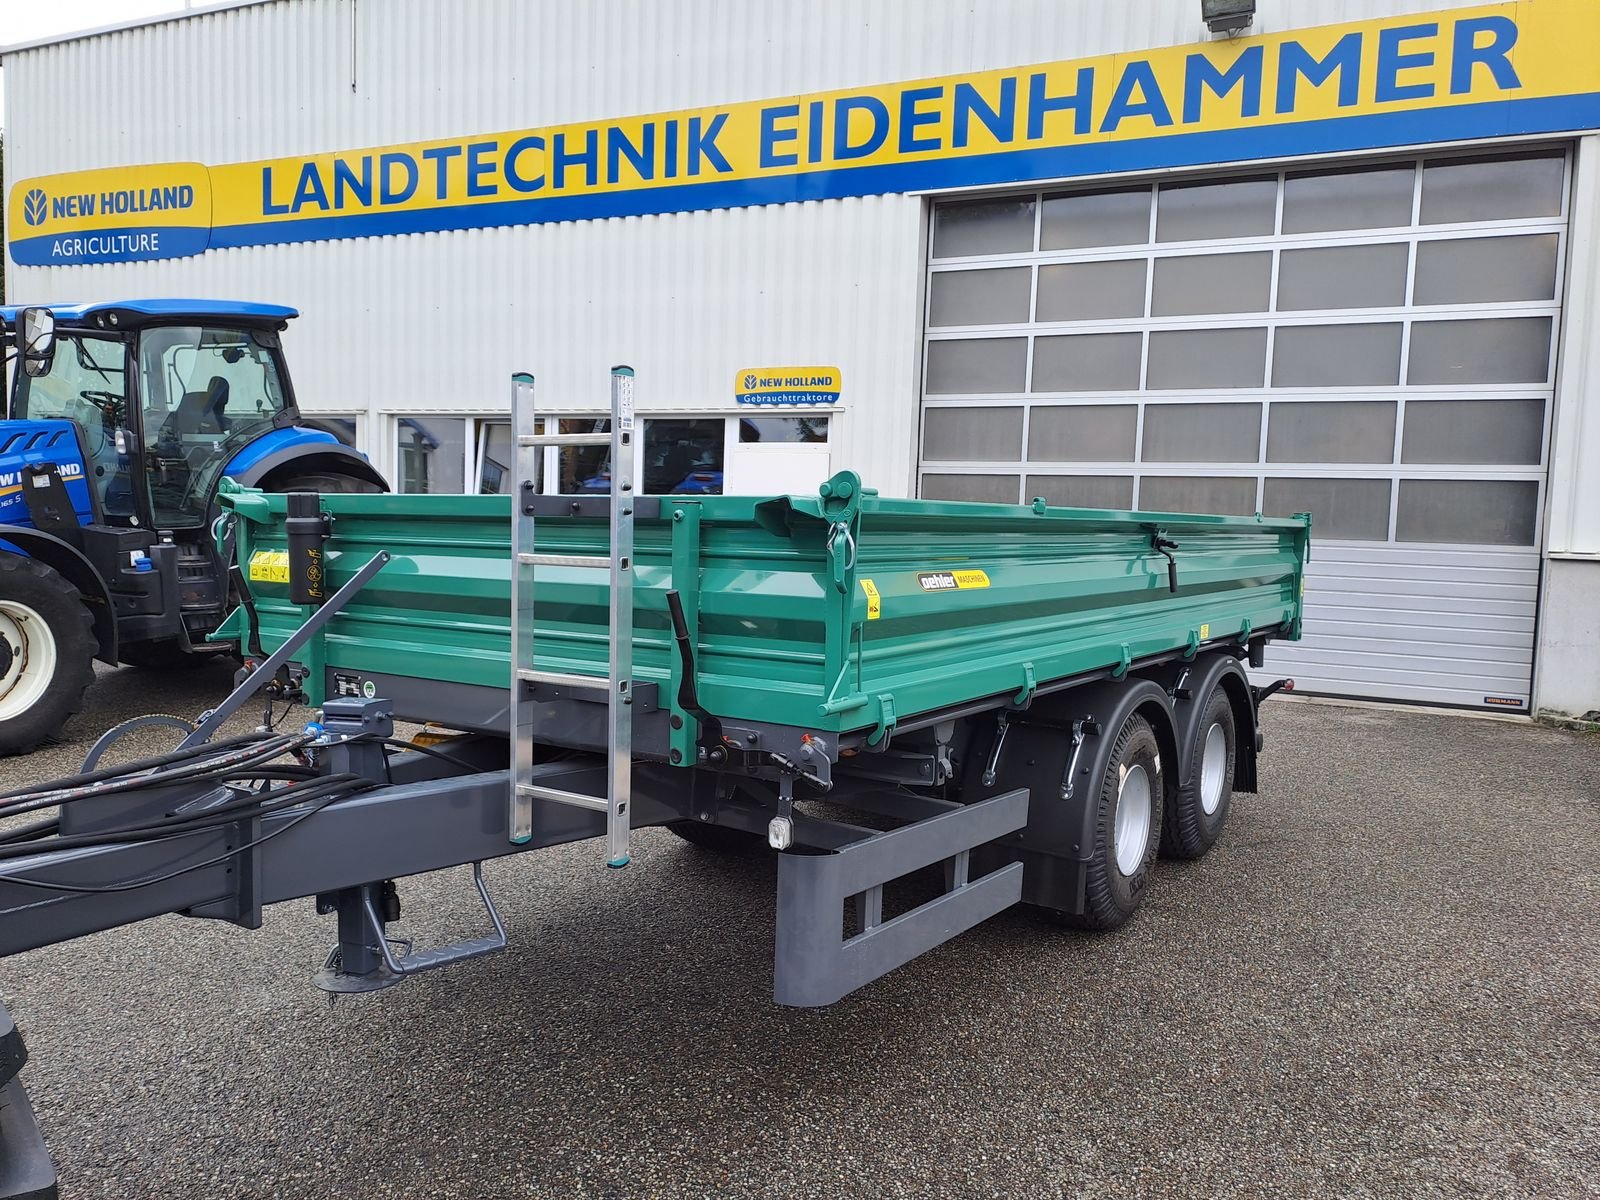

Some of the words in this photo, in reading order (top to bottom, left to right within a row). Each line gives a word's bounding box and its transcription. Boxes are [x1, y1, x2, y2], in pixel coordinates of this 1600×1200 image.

[261, 113, 733, 216] LANDTECHNIK
[759, 15, 1522, 169] EIDENHAMMER
[52, 194, 96, 219] NEW
[101, 185, 194, 215] HOLLAND
[52, 233, 160, 257] AGRICULTURE
[759, 377, 782, 387] NEW
[785, 377, 832, 386] HOLLAND
[743, 393, 833, 403] Gebrauchttraktore
[921, 574, 956, 588] oehler
